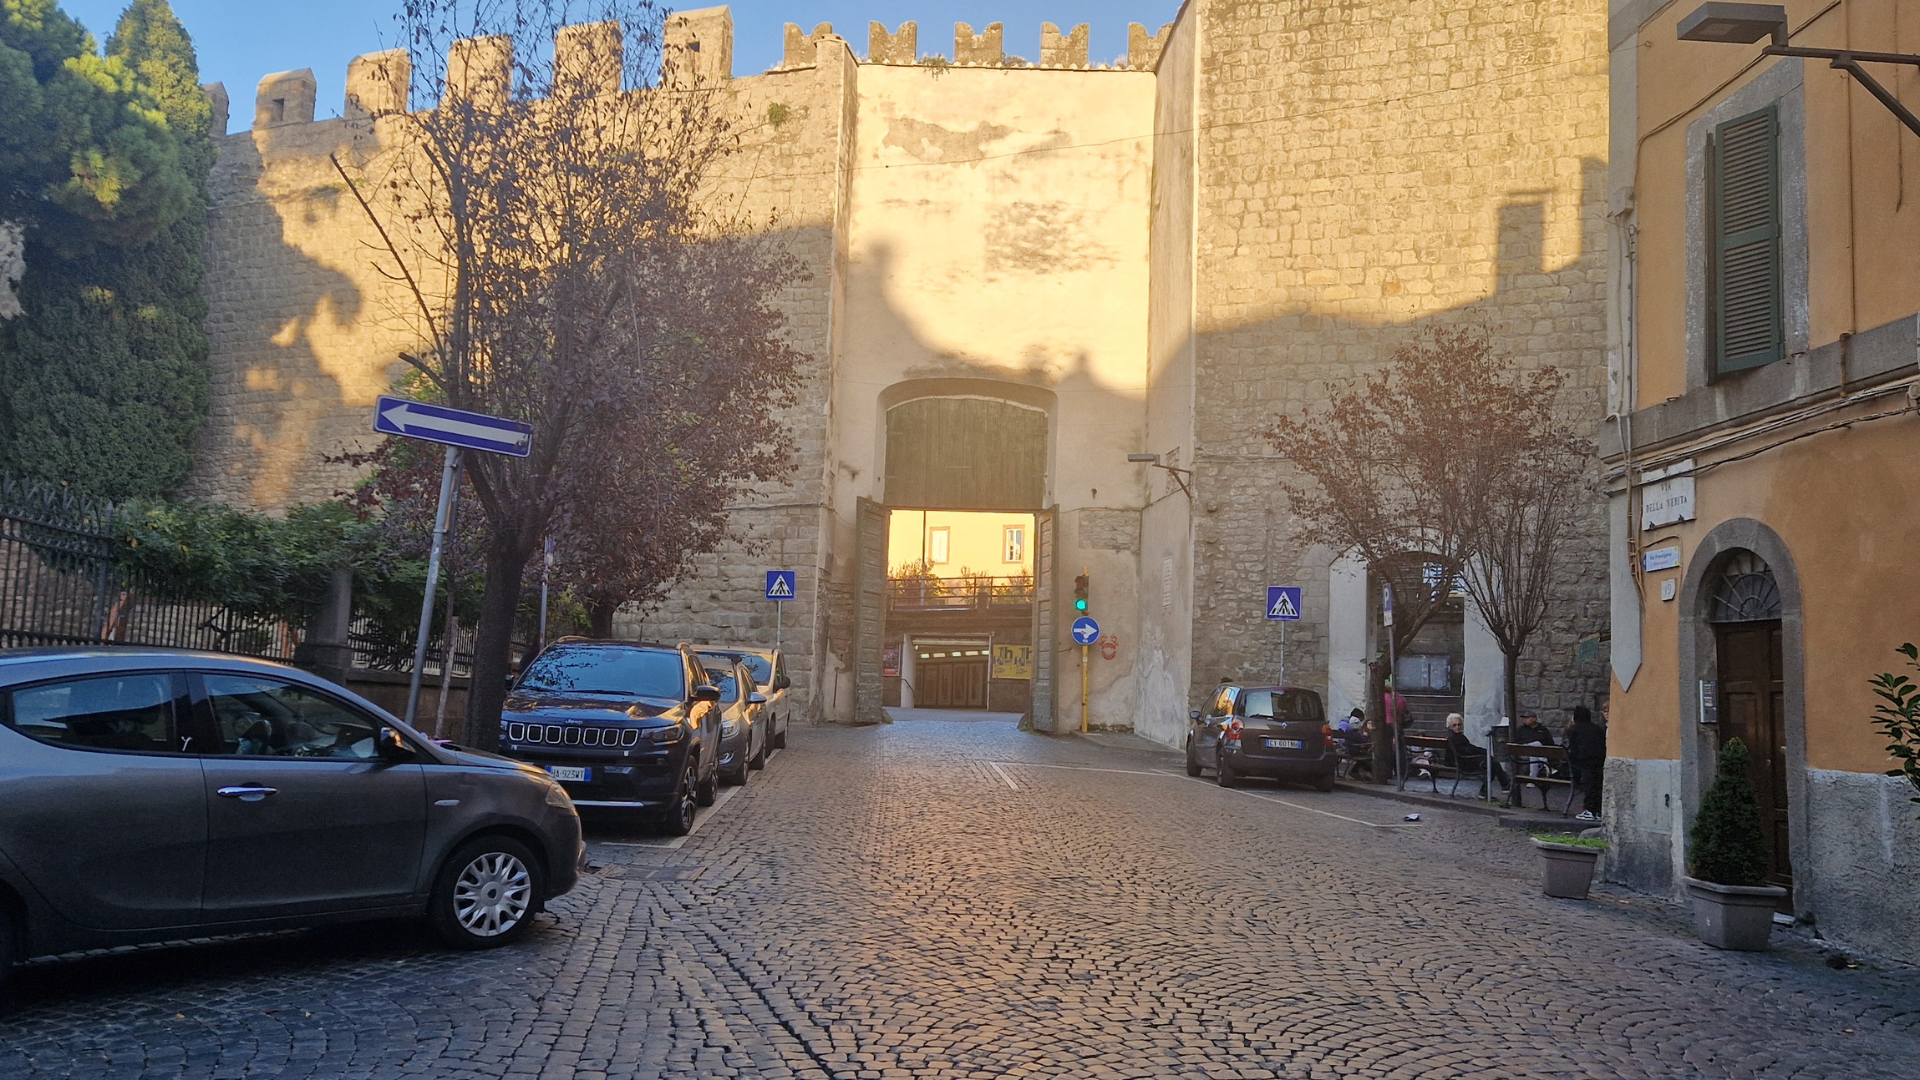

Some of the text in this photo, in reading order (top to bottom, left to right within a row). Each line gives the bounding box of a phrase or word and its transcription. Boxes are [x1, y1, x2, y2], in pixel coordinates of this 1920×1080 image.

[1660, 483, 1671, 491] VIA
[1646, 502, 1663, 513] DELLA
[1384, 587, 1389, 608] P
